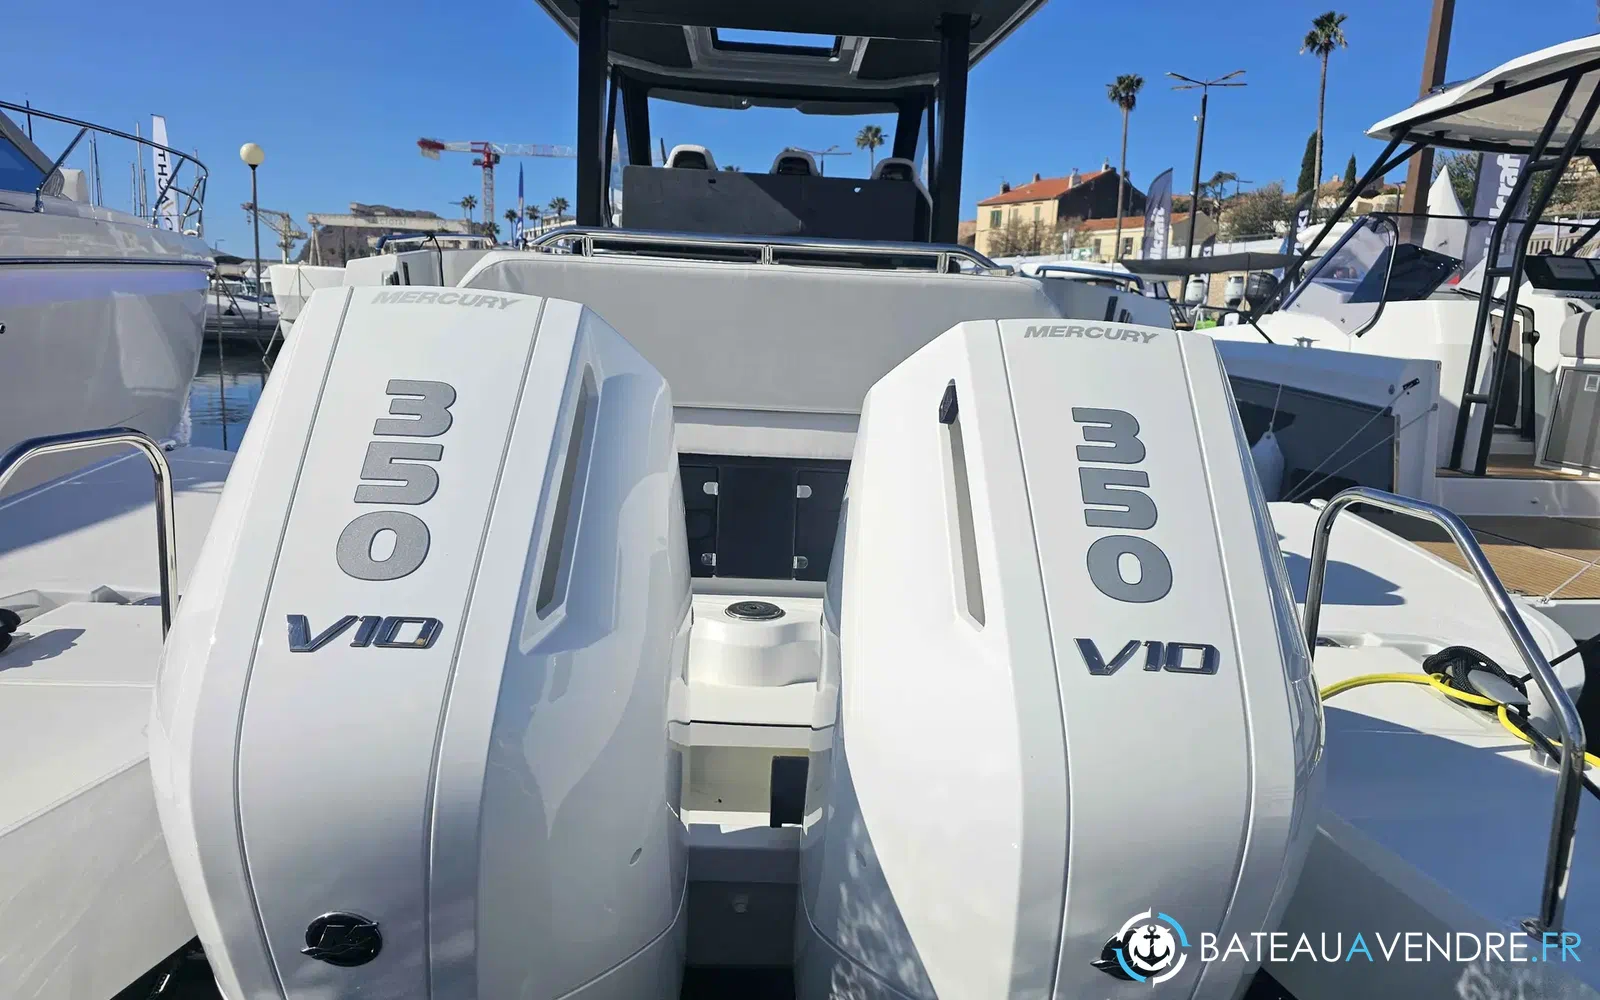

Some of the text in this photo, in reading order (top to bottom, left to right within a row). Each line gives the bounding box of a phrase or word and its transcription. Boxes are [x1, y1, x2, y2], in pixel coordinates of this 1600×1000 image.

[371, 291, 521, 310] MERCURY
[1024, 325, 1159, 344] MERCURY
[336, 379, 457, 581] 350
[1071, 406, 1173, 603] 350
[286, 614, 443, 652] V10
[1073, 637, 1220, 675] V10
